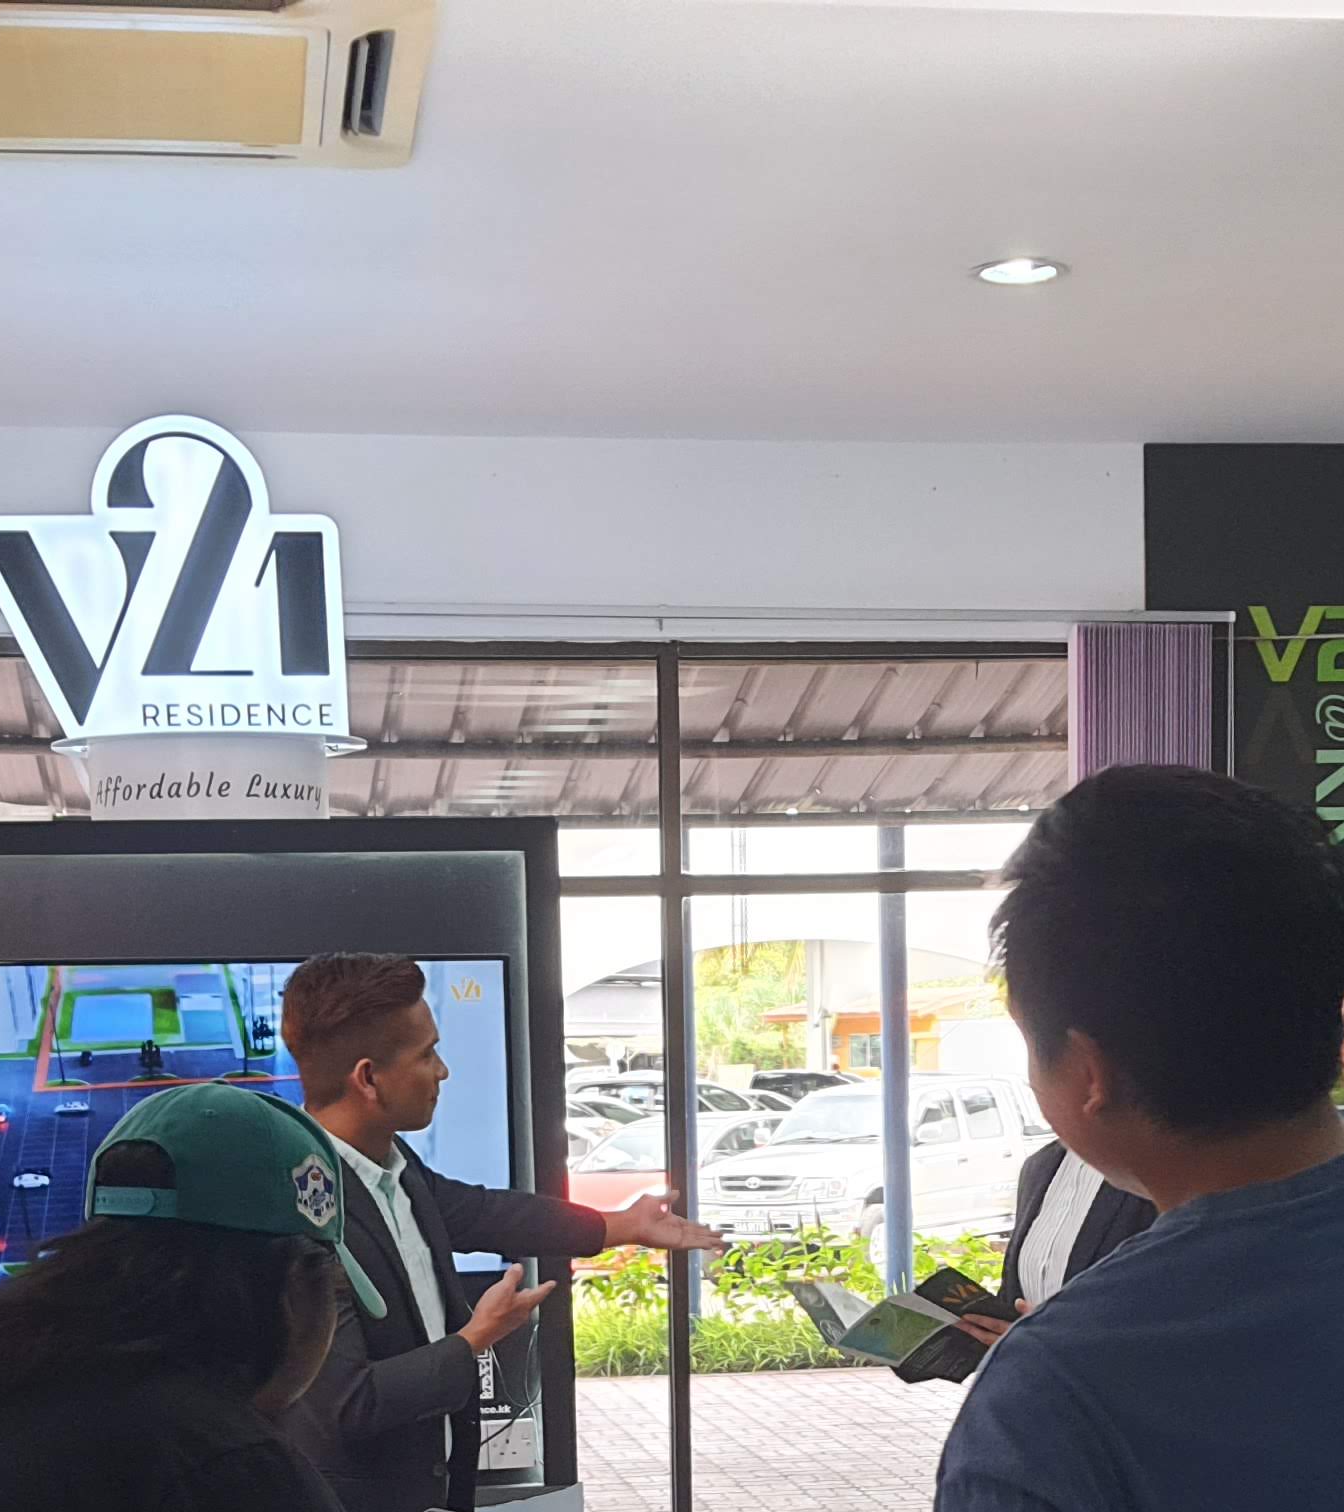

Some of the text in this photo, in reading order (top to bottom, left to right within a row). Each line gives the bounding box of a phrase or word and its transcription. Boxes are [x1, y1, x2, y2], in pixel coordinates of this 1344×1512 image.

[141, 703, 334, 727] RESIDENCE
[95, 770, 322, 810] Affordable Luxury
